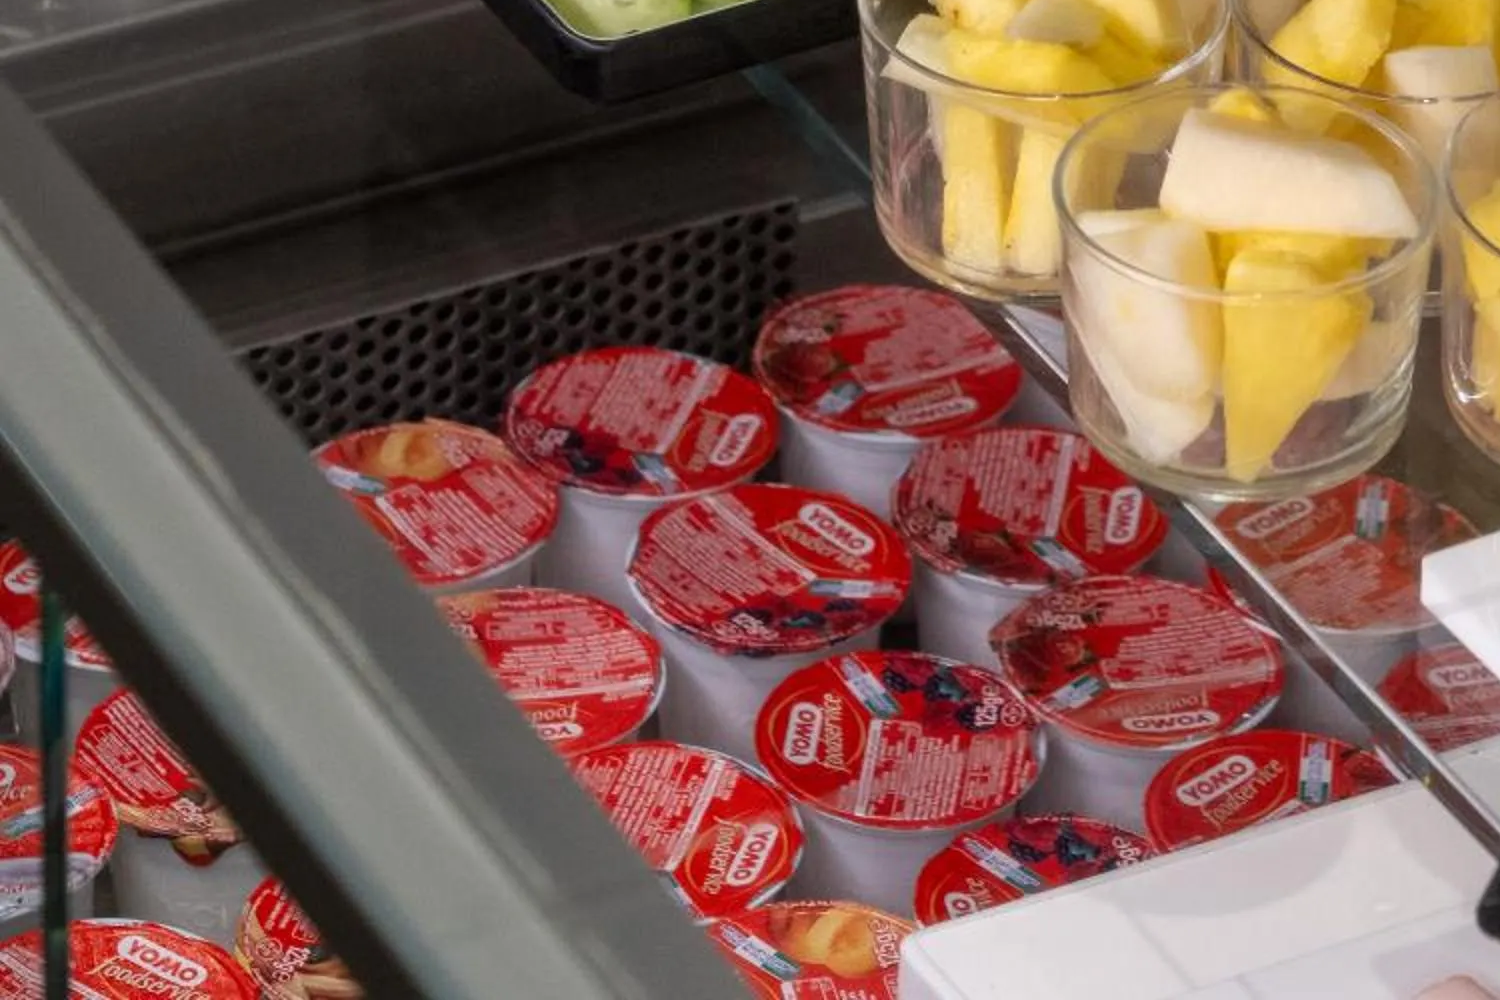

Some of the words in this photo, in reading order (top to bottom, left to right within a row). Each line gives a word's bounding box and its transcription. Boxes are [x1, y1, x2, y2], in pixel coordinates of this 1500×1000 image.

[808, 507, 867, 550] YOMO
[1114, 493, 1139, 540] YOMO
[1437, 664, 1493, 684] YOM
[790, 709, 816, 759] YOMO
[817, 693, 850, 774] foodservice
[1132, 713, 1210, 729] YOMO
[1183, 761, 1247, 800] YOMO
[1201, 758, 1285, 833] foodservice
[703, 814, 748, 894] foodservice
[734, 830, 773, 880] YOMO
[127, 938, 198, 982] YOMO
